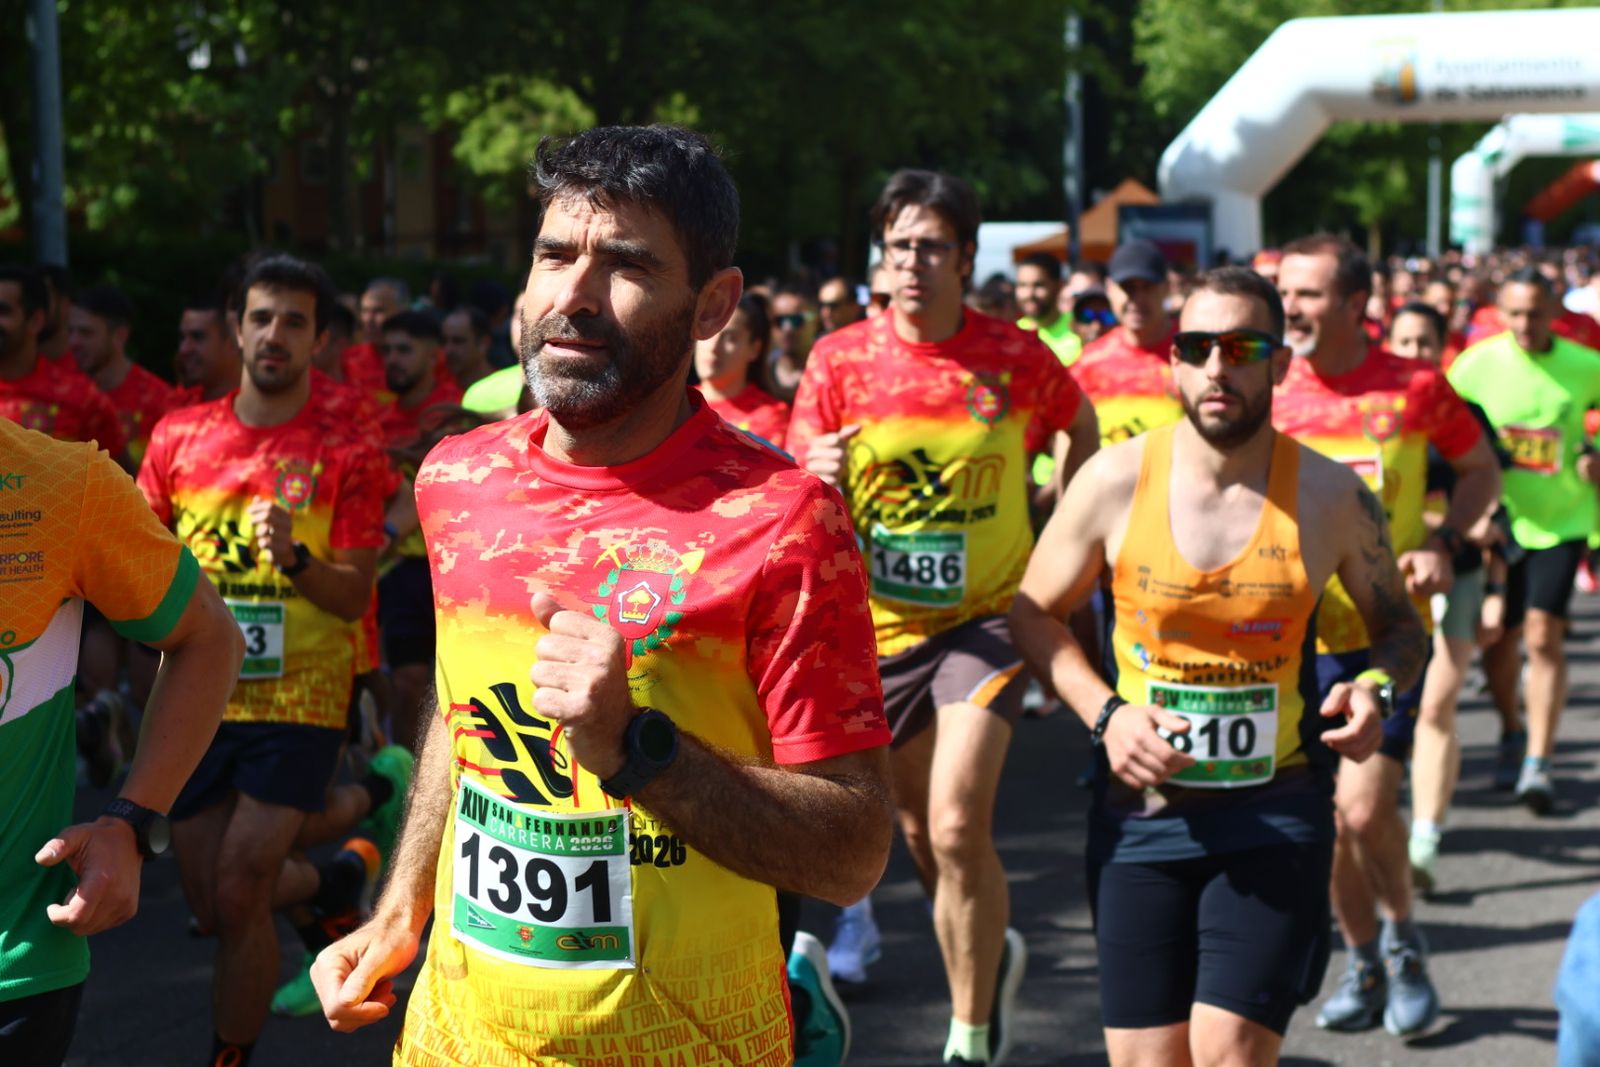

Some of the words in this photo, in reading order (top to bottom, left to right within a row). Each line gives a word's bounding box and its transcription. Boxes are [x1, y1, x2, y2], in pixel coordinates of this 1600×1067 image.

[874, 546, 961, 585] 1486
[460, 787, 490, 827] XIV
[492, 803, 513, 825] SAN
[526, 817, 617, 837] FERNANDO
[490, 819, 565, 850] CARRERA
[629, 833, 687, 868] 2026
[460, 831, 613, 923] 1391
[624, 1022, 694, 1054] VICTORIA
